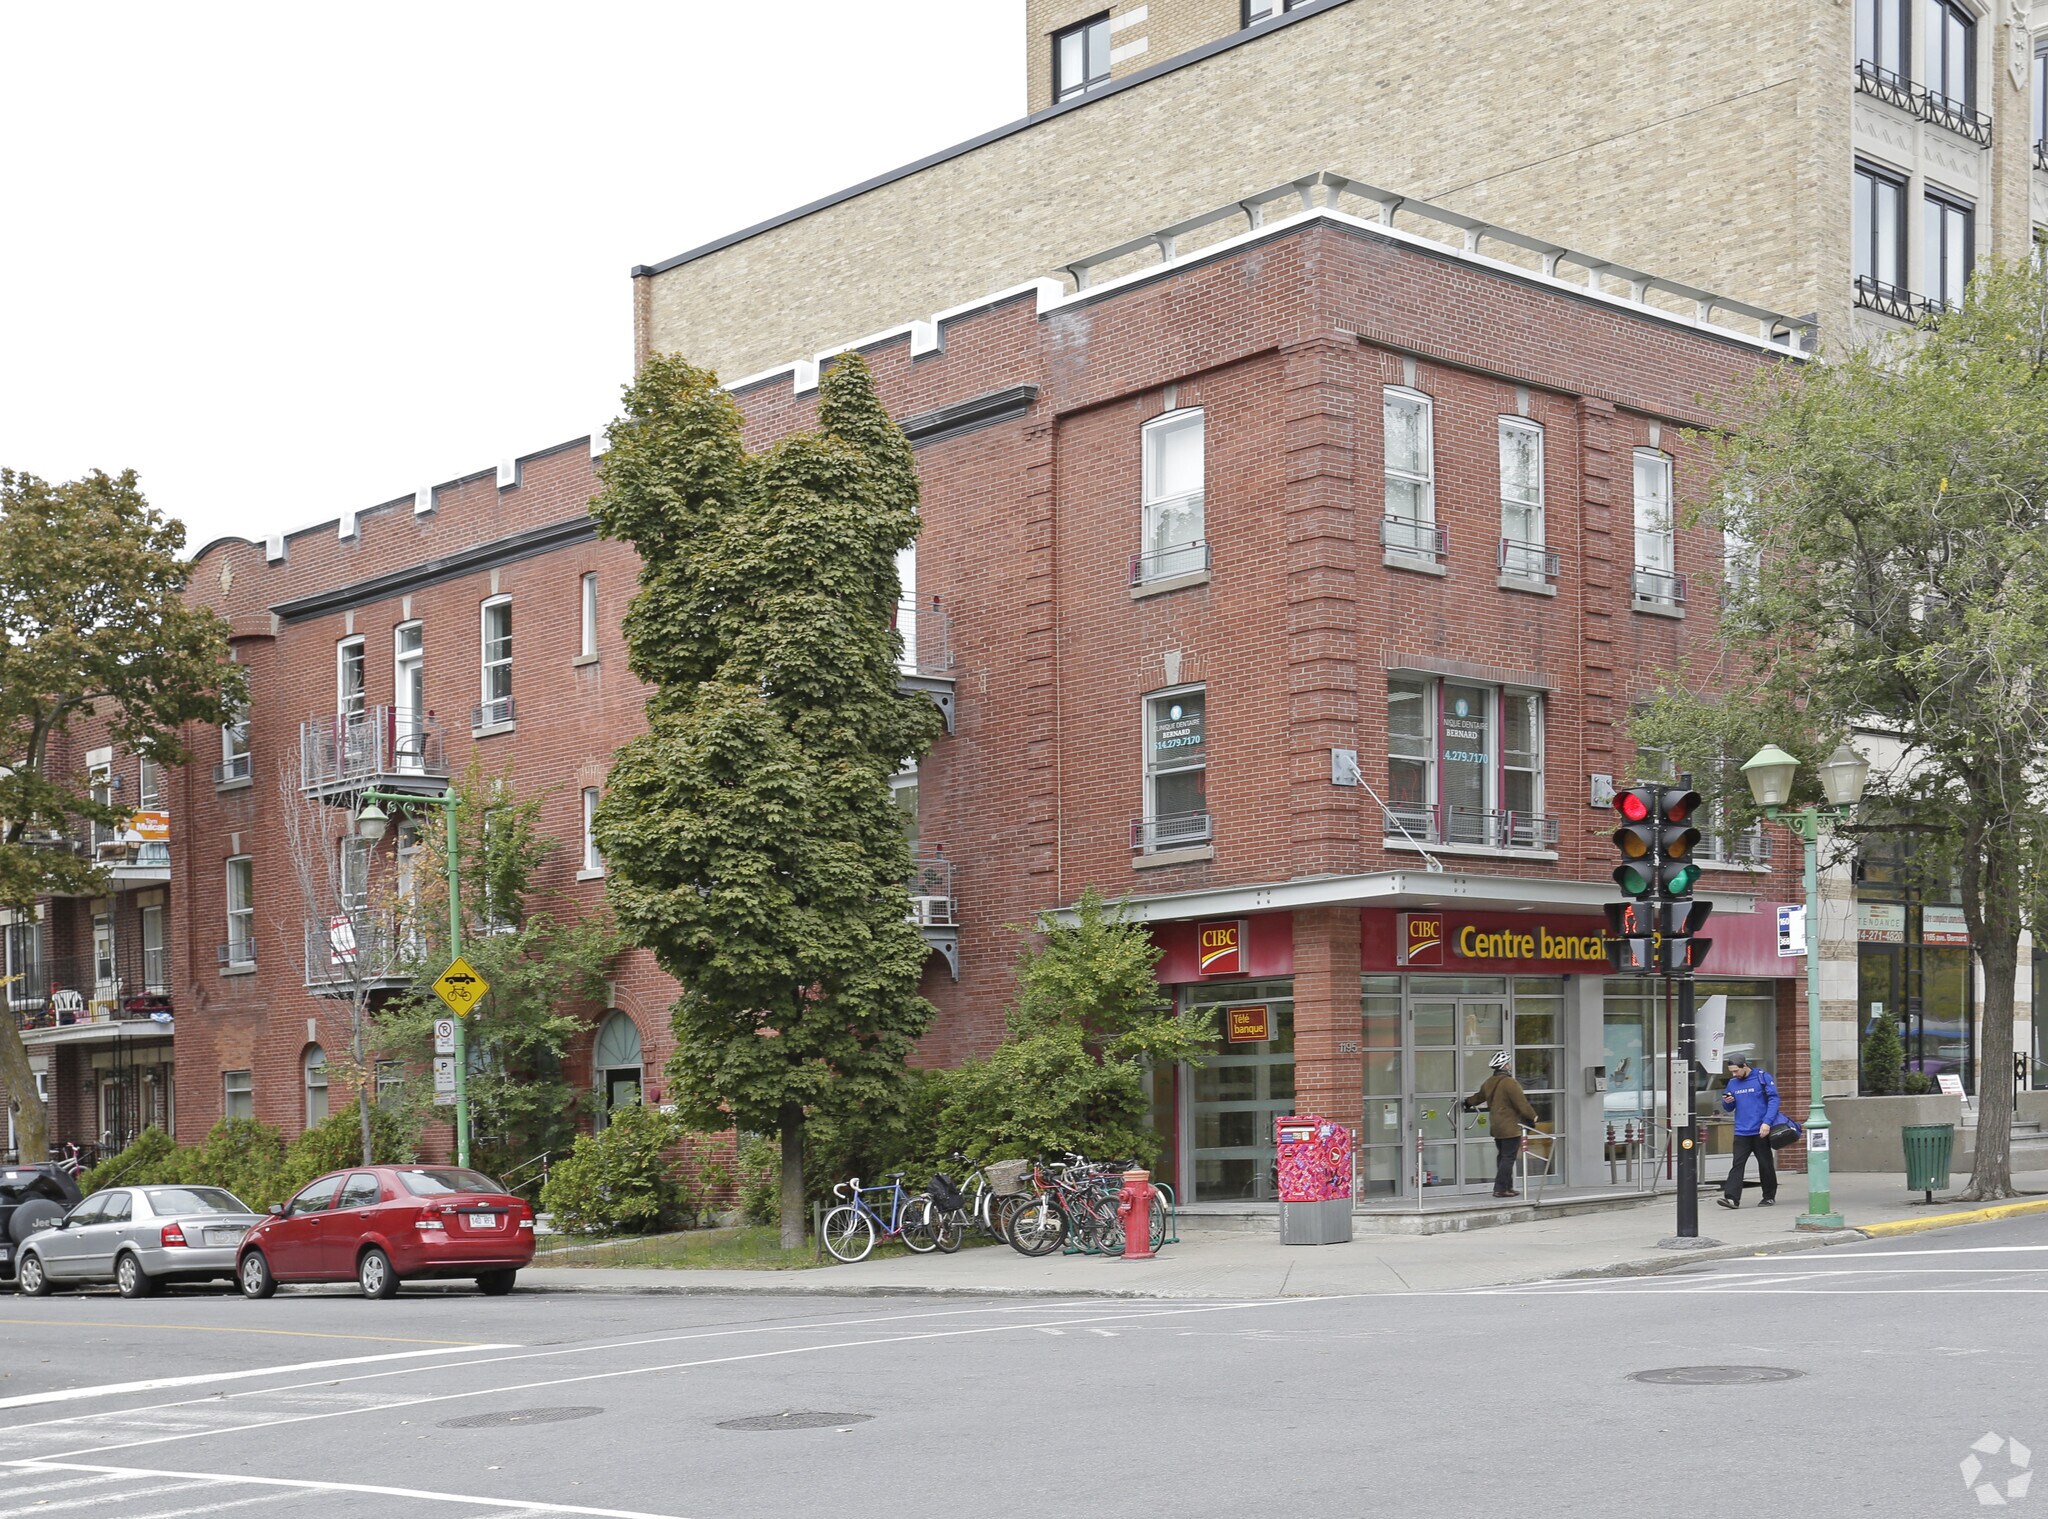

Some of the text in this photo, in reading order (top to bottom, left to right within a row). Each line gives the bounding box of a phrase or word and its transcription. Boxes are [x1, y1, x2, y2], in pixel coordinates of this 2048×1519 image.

[1175, 718, 1200, 729] DENTAIRE
[1443, 718, 1489, 731] NIQUE DENTAIRE
[1162, 728, 1191, 739] BERNARD
[1446, 728, 1478, 739] BERNARD
[1153, 735, 1201, 750] 514.279.7170
[1779, 917, 1789, 926] 160
[1410, 920, 1440, 938] CIBC
[1202, 928, 1237, 947] CIBC
[1857, 930, 1903, 942] 14-271-4820
[1946, 933, 1968, 943] Bernard
[1460, 925, 1535, 958] Centre
[1540, 926, 1620, 960] bancai
[1233, 1013, 1250, 1024] Télé
[1234, 1024, 1264, 1035] banque
[1339, 1042, 1358, 1053] 1195
[441, 1062, 448, 1070] P
[31, 1218, 50, 1228] Jee
